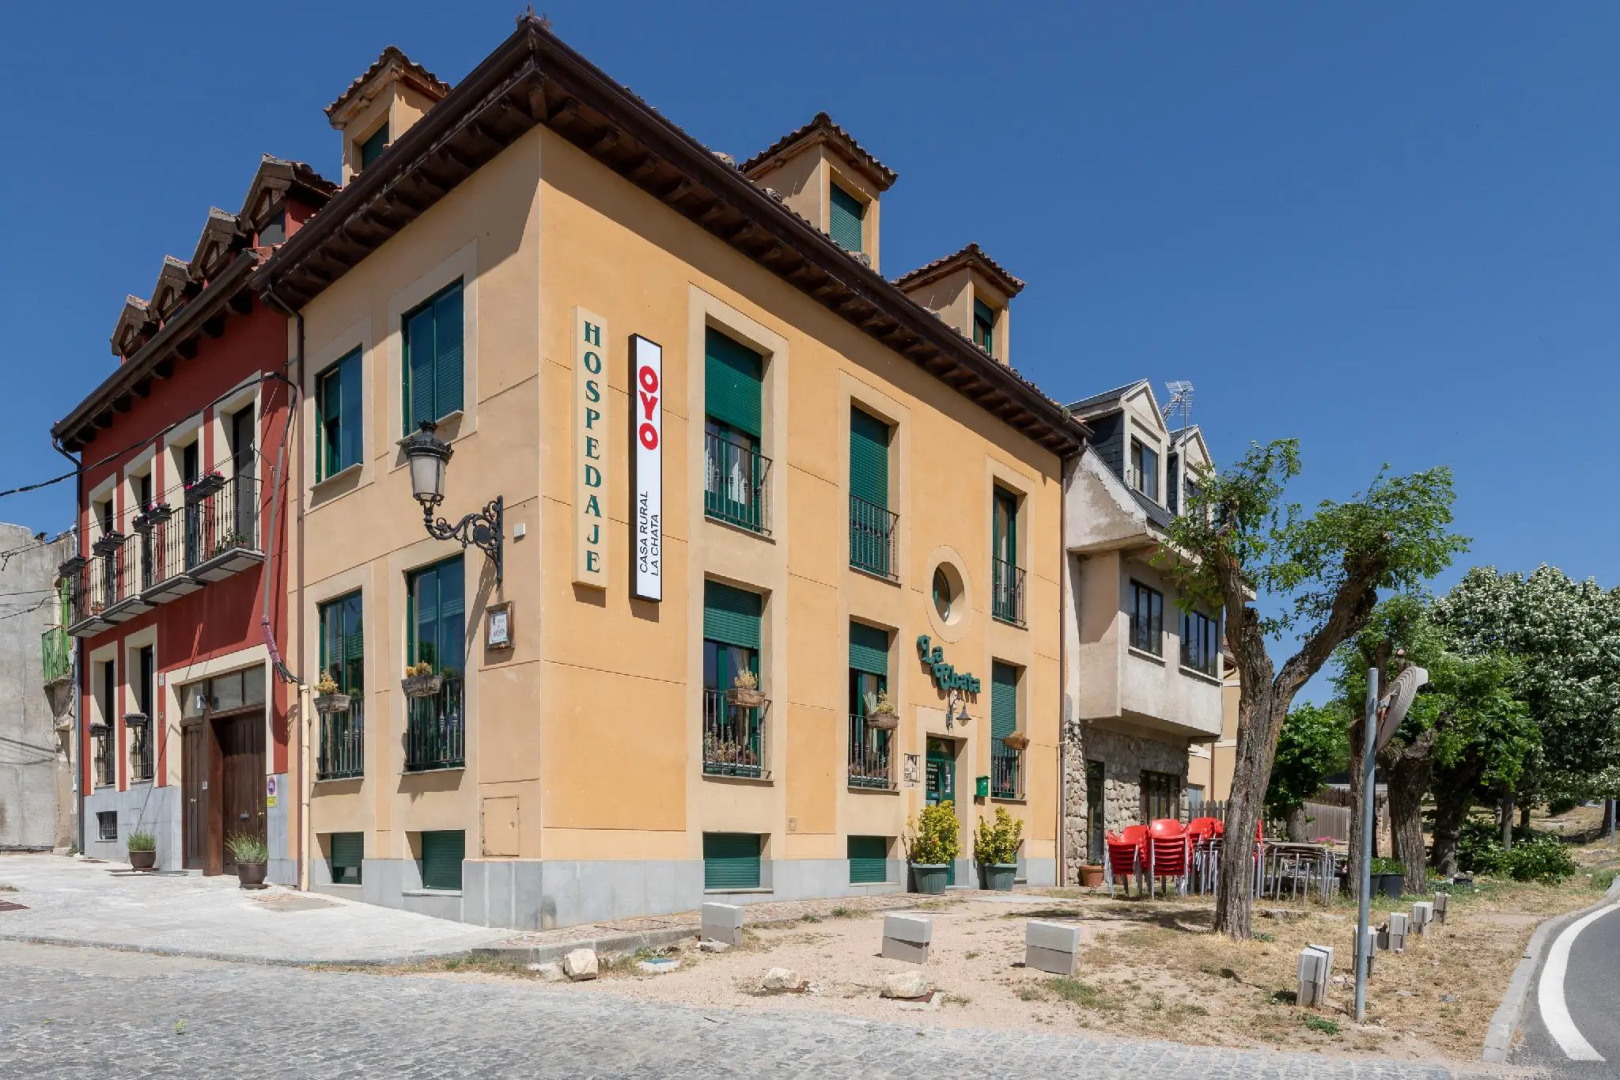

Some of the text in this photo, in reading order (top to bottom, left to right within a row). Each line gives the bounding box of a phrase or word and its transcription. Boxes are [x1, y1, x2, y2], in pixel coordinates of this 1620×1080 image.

[639, 365, 658, 451] OYO
[584, 320, 602, 574] HOSPEDAJE
[640, 491, 648, 573] CASA RURAL
[651, 514, 659, 576] LA CHATA
[916, 635, 944, 663] La
[932, 663, 981, 694] Chata
